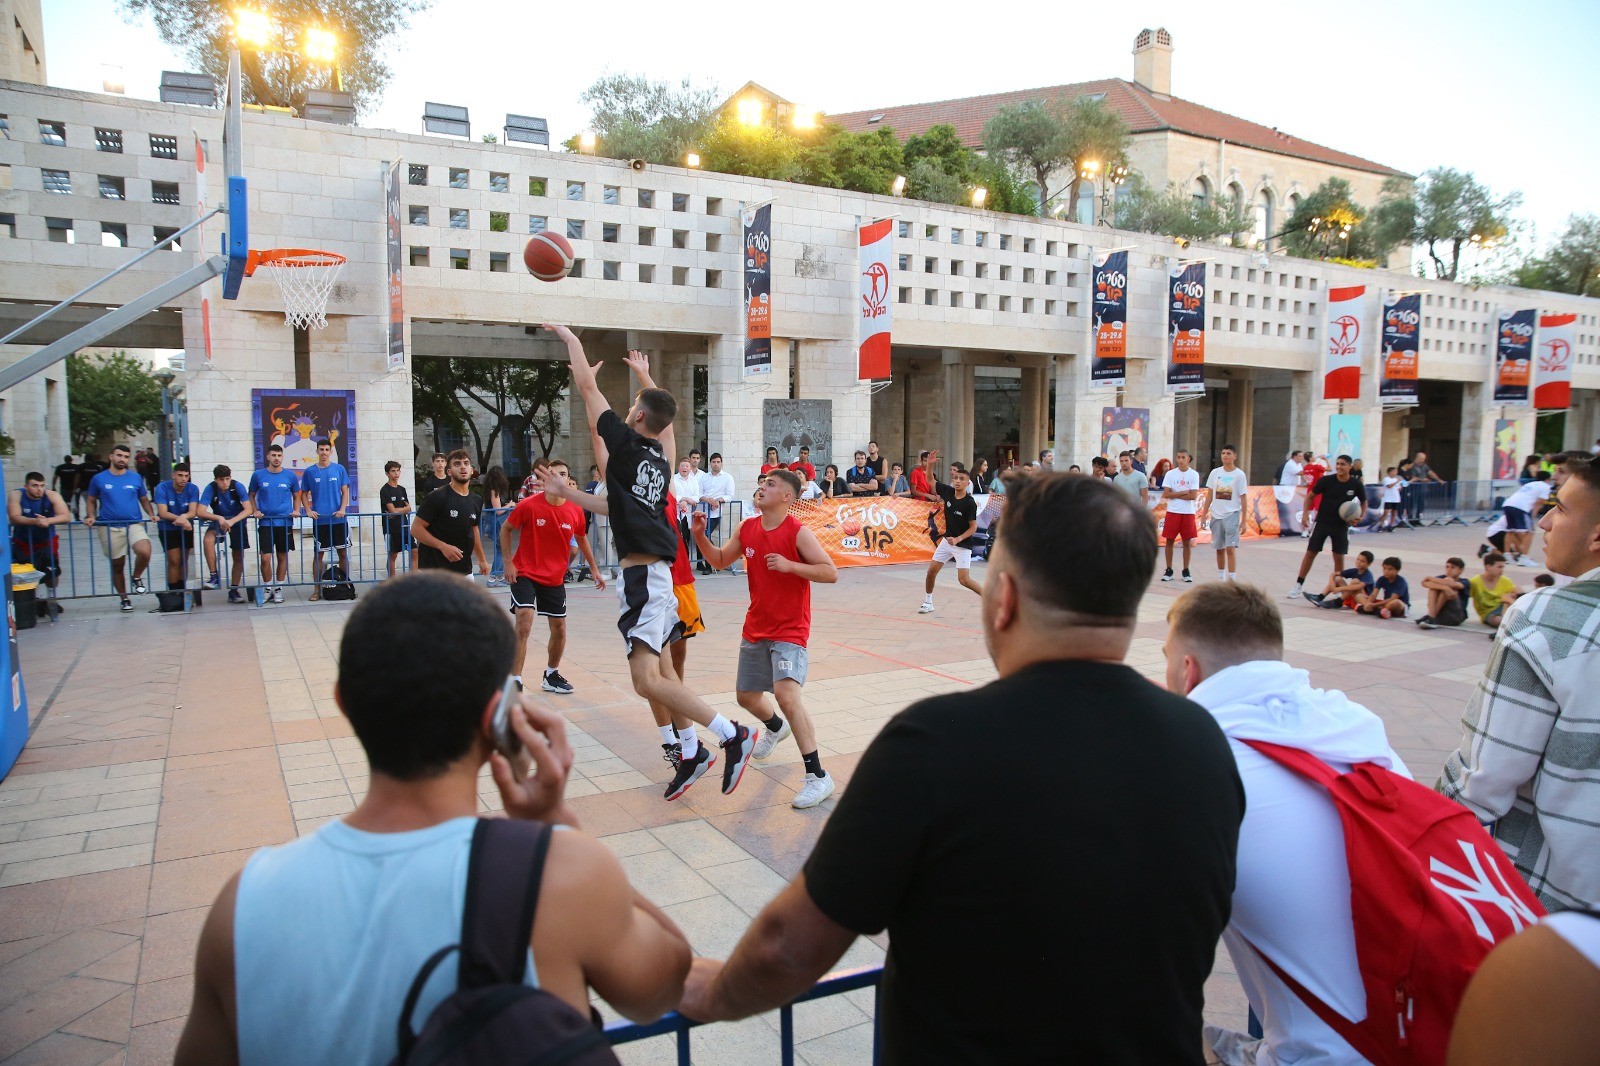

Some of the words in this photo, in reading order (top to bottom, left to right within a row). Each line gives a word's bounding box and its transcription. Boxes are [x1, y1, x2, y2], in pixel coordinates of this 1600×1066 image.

[1100, 331, 1122, 340] 28-29.6
[1176, 338, 1201, 347] 28-29.6
[835, 503, 898, 530] סטריט
[863, 525, 894, 551] בול
